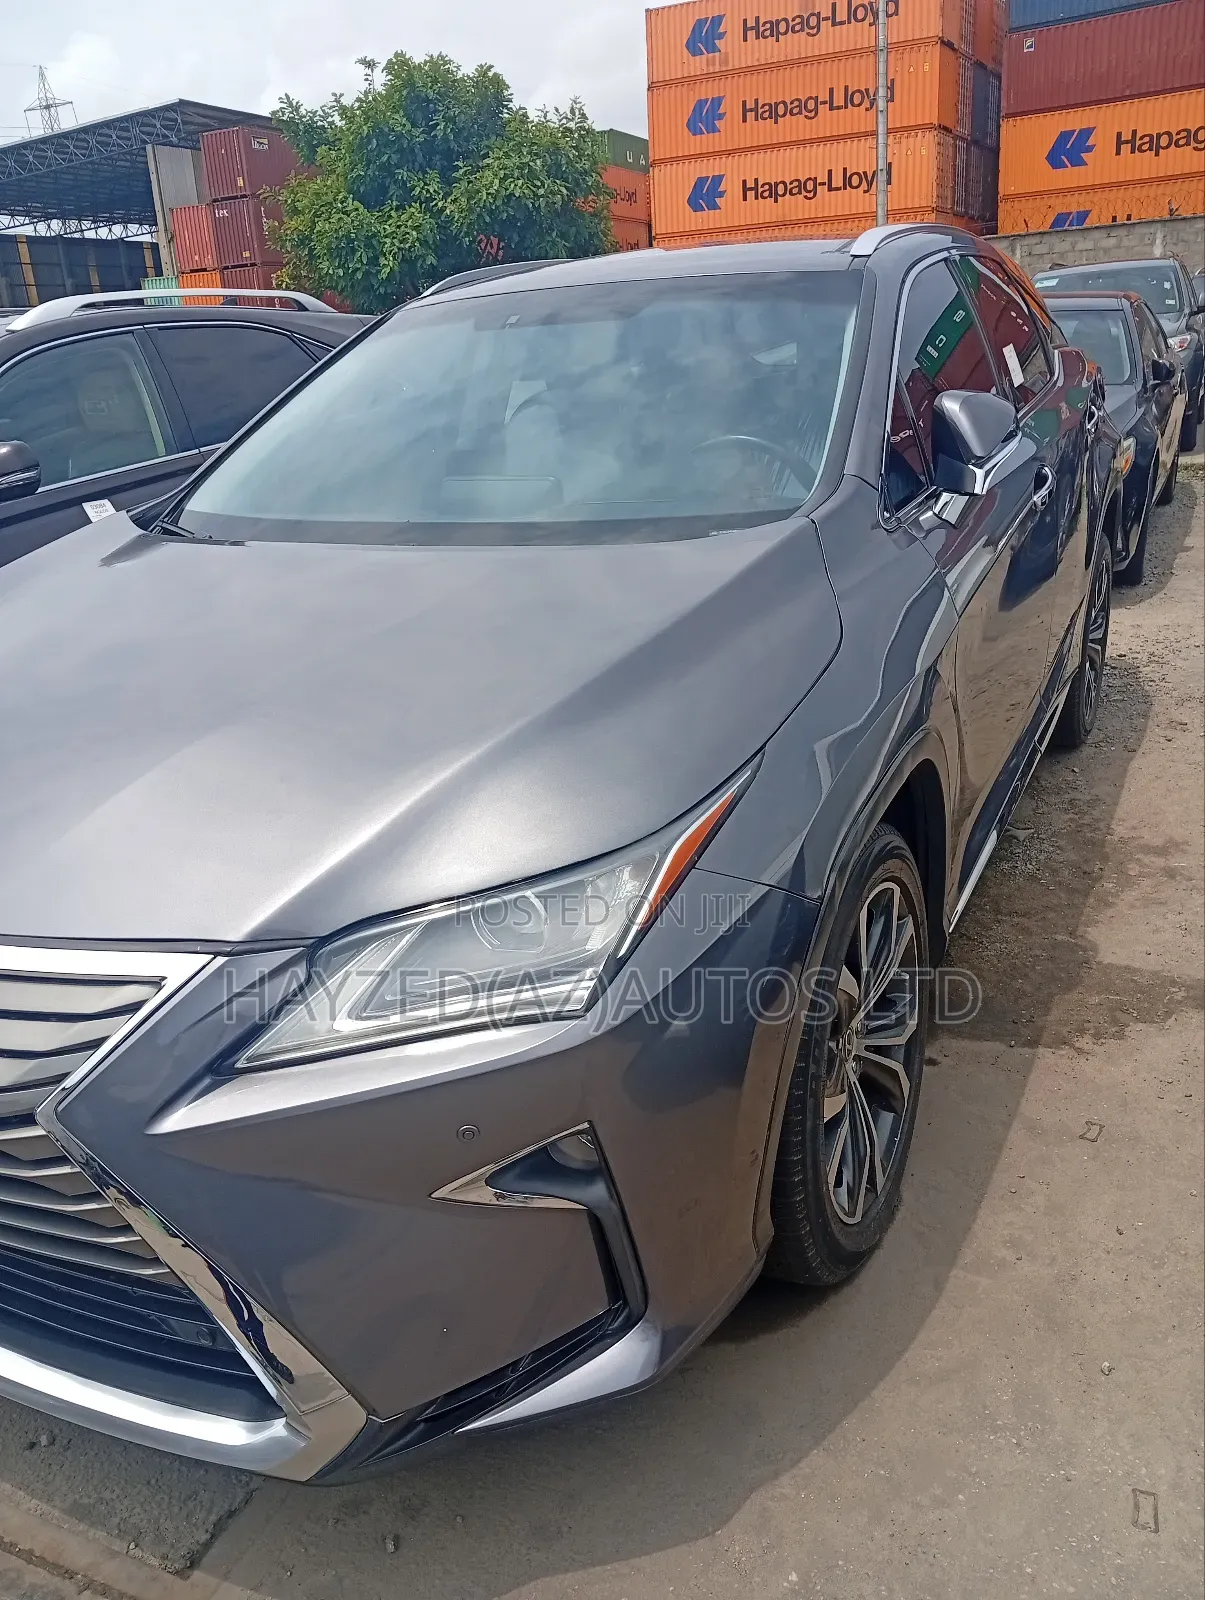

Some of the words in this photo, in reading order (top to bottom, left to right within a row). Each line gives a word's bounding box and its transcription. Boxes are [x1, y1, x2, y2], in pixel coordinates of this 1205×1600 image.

[742, 0, 900, 42] Hapag-Lloyd
[742, 78, 895, 124] Hapag-Lloyd
[214, 207, 229, 218] tex
